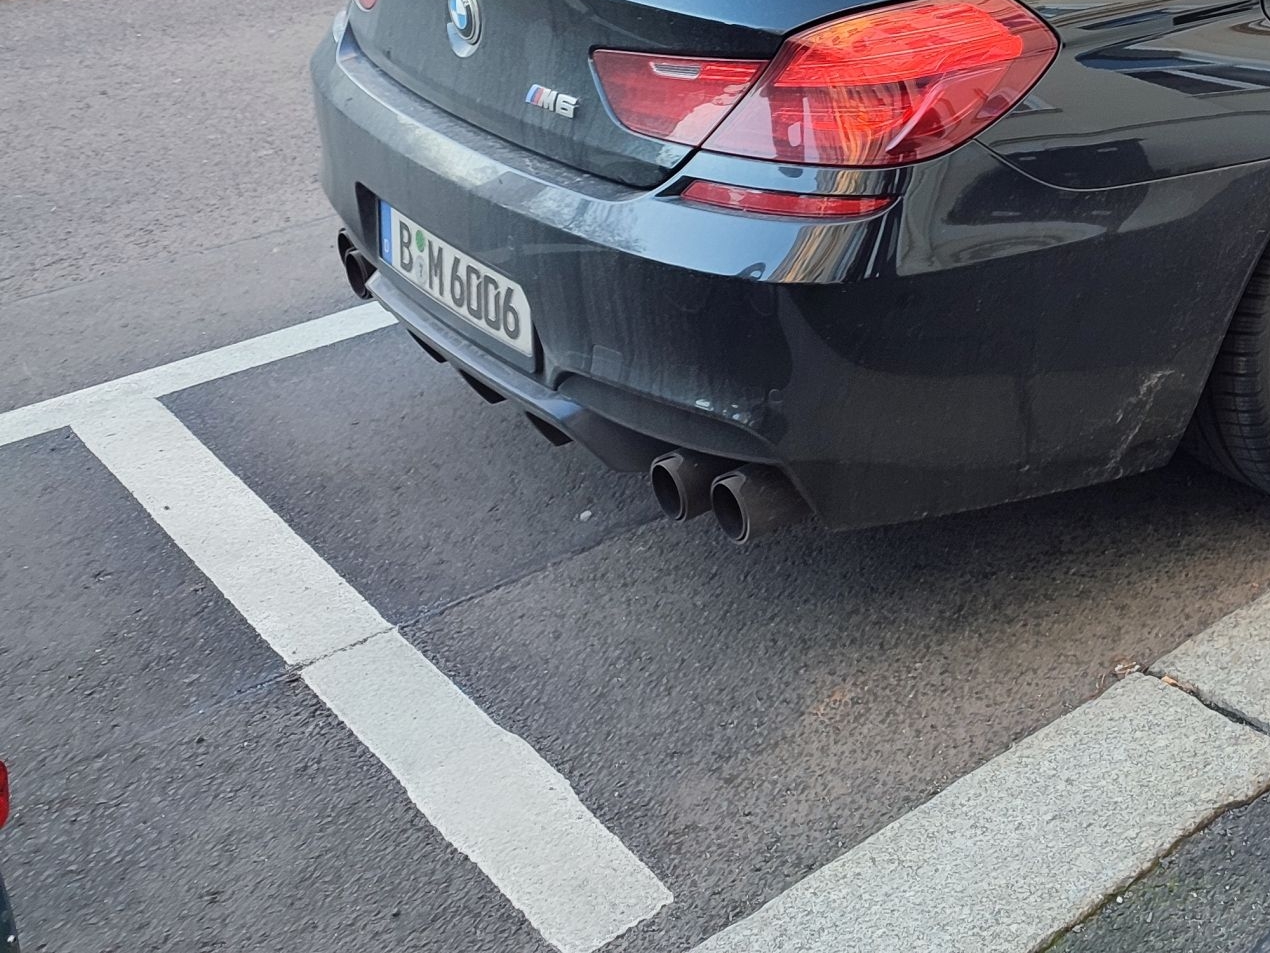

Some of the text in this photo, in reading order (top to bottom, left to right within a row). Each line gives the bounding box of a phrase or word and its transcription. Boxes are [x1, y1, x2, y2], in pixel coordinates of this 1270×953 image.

[399, 220, 414, 273] B
[428, 239, 444, 297] M
[451, 255, 521, 341] 6006
